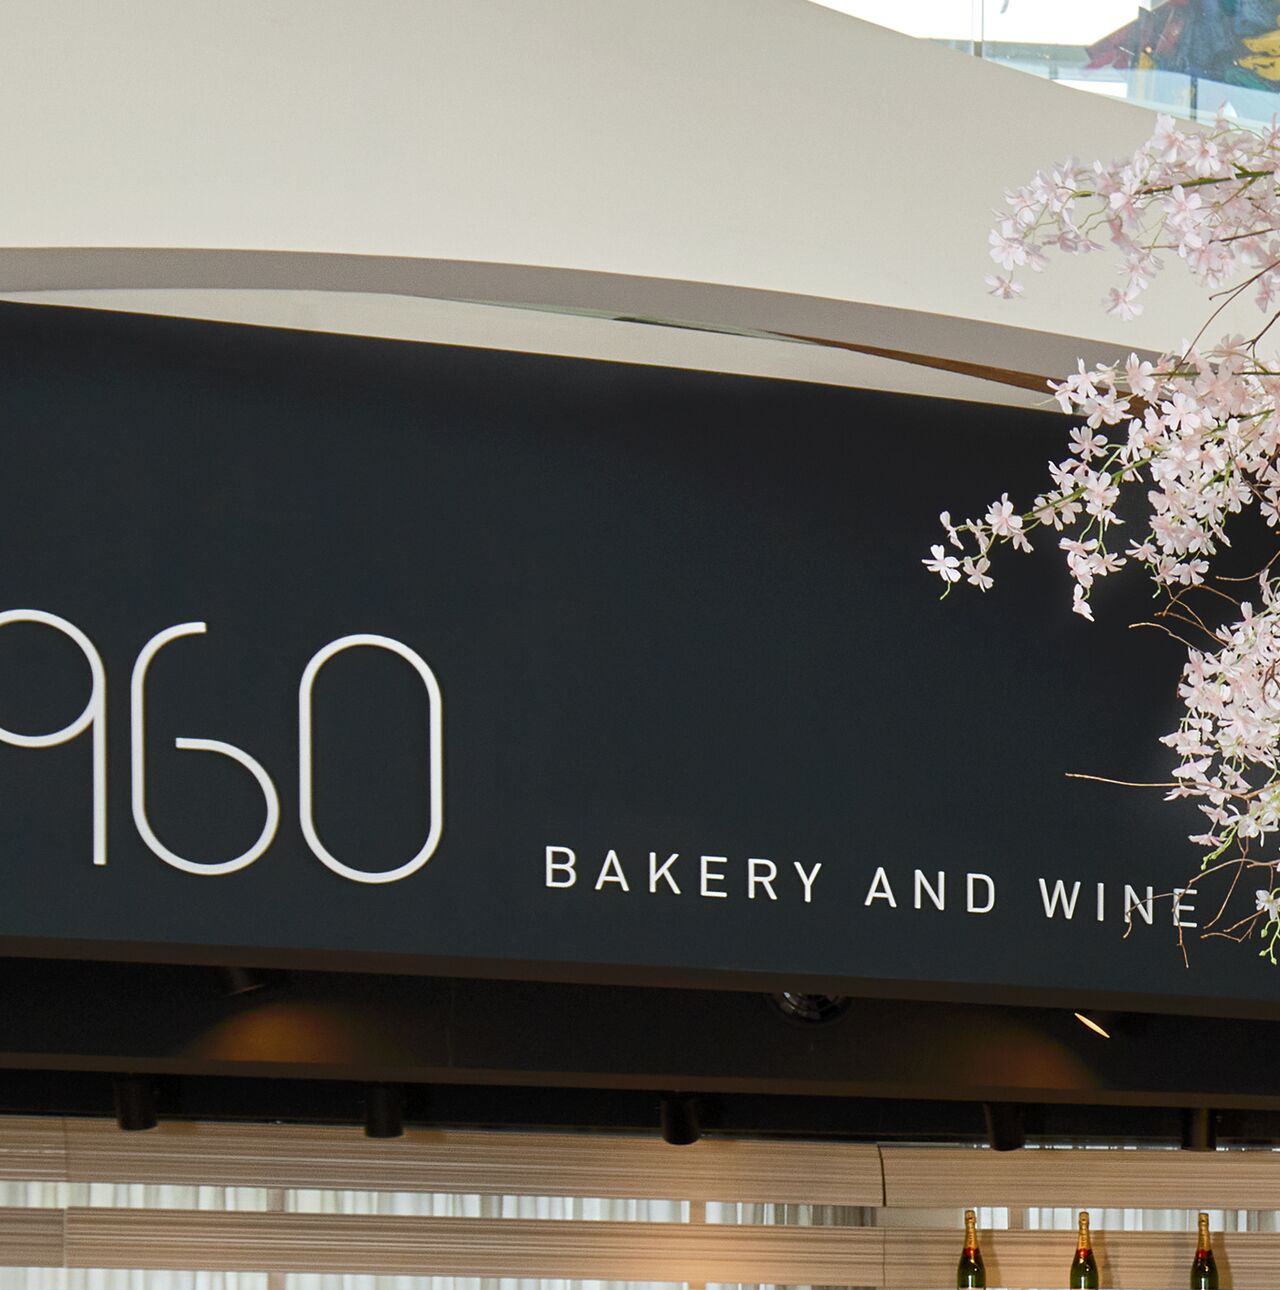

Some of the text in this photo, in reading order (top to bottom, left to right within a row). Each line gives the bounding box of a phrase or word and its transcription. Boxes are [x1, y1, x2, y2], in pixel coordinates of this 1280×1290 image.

[0, 609, 442, 884] 960
[545, 845, 1198, 928] BAKERY AND WINE
